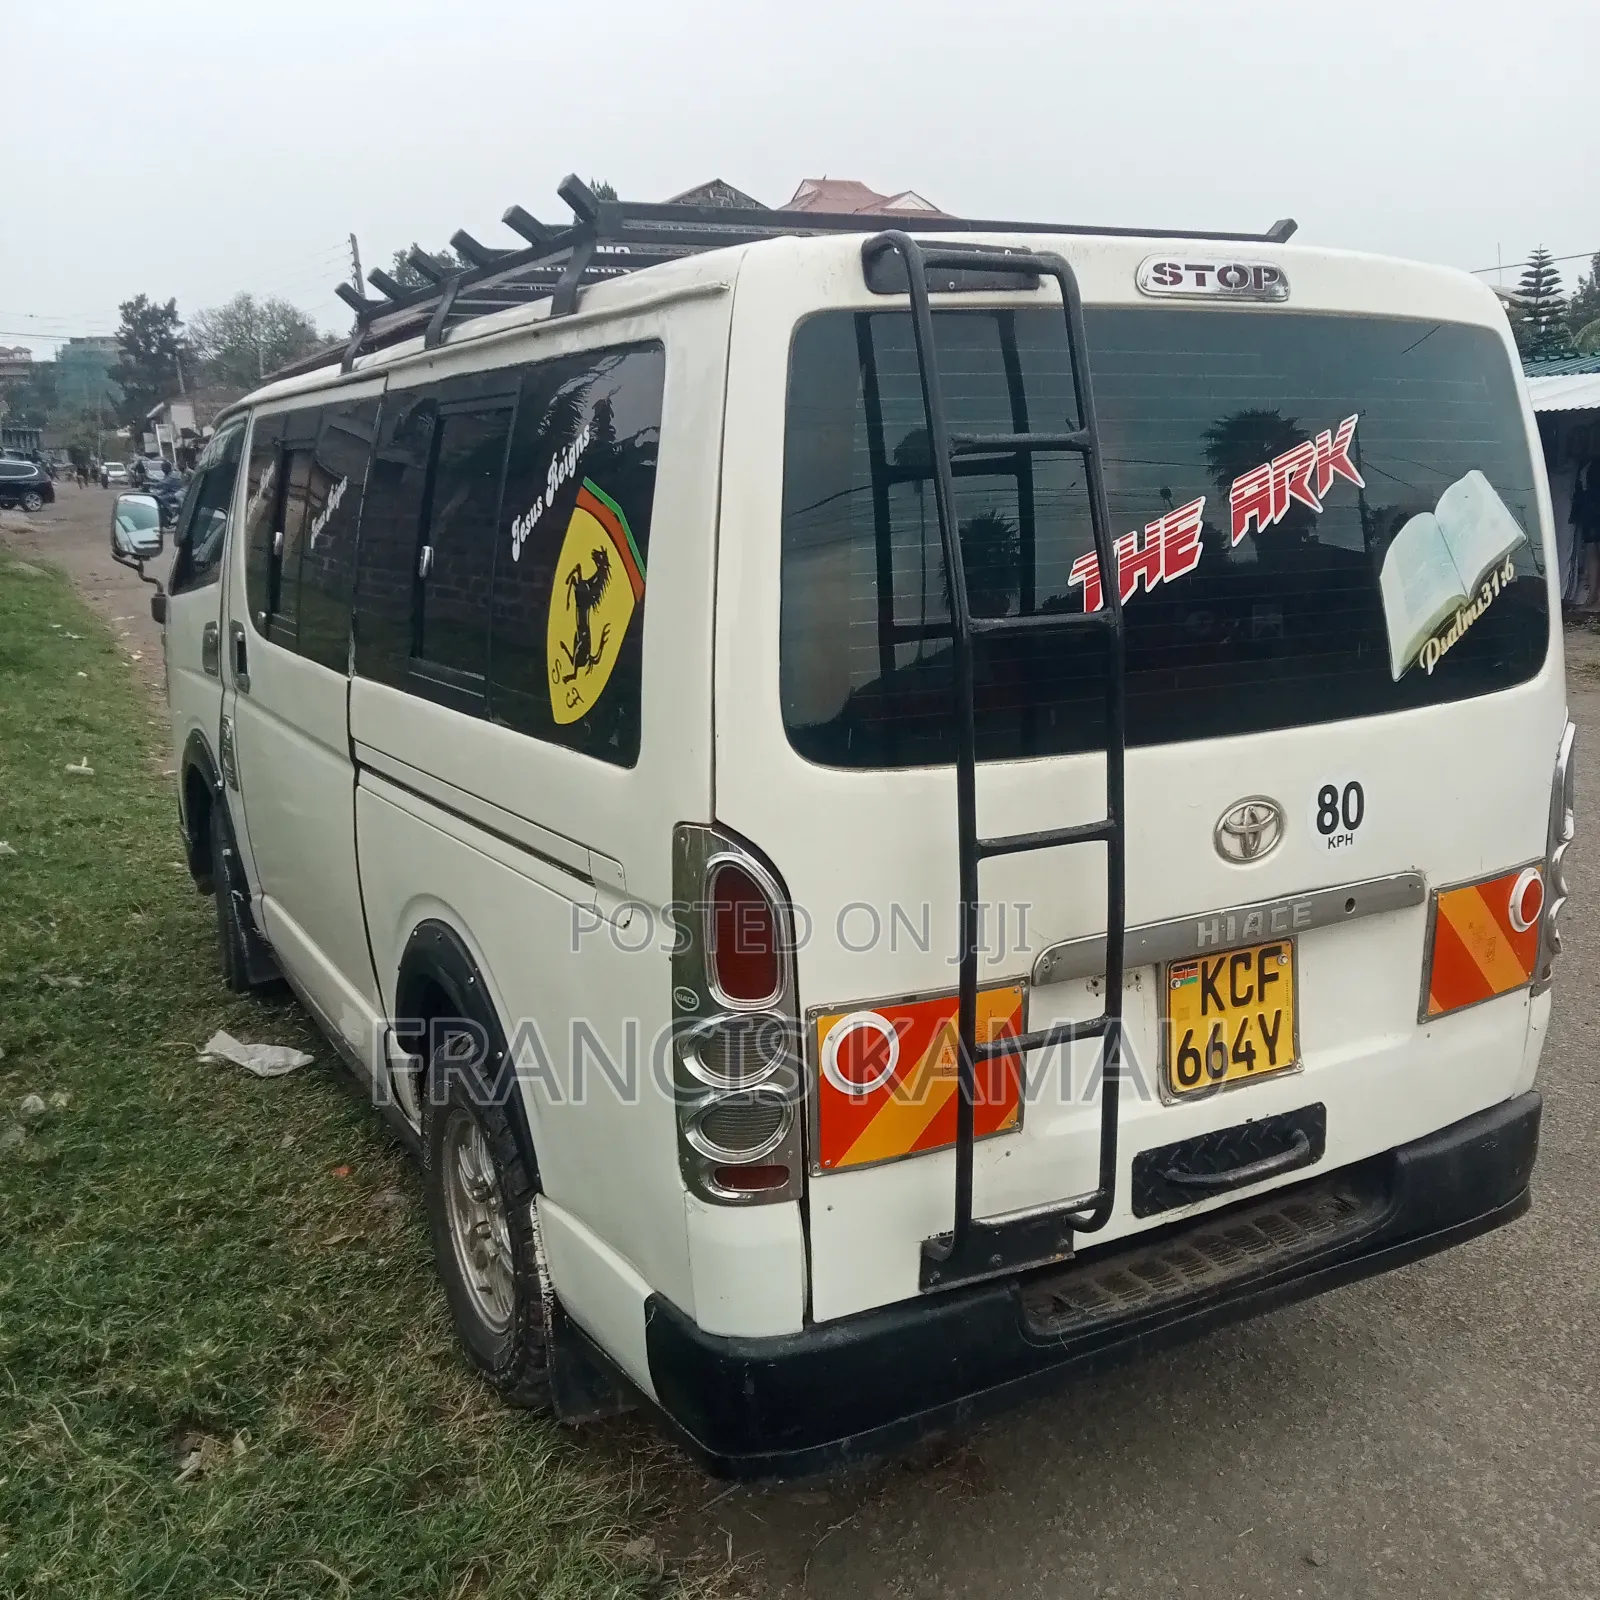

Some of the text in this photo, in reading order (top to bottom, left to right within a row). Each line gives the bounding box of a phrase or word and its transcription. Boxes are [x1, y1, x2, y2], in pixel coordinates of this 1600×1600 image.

[1152, 262, 1280, 290] STOP
[511, 424, 590, 563] Jesus Reigns
[1068, 413, 1366, 613] THE ARK
[1316, 780, 1365, 835] 80
[1327, 832, 1354, 850] KPH
[1196, 900, 1313, 948] HIACE
[676, 992, 696, 1005] HIACE
[1200, 945, 1283, 1016] KCF
[1177, 1008, 1282, 1086] 664Y
